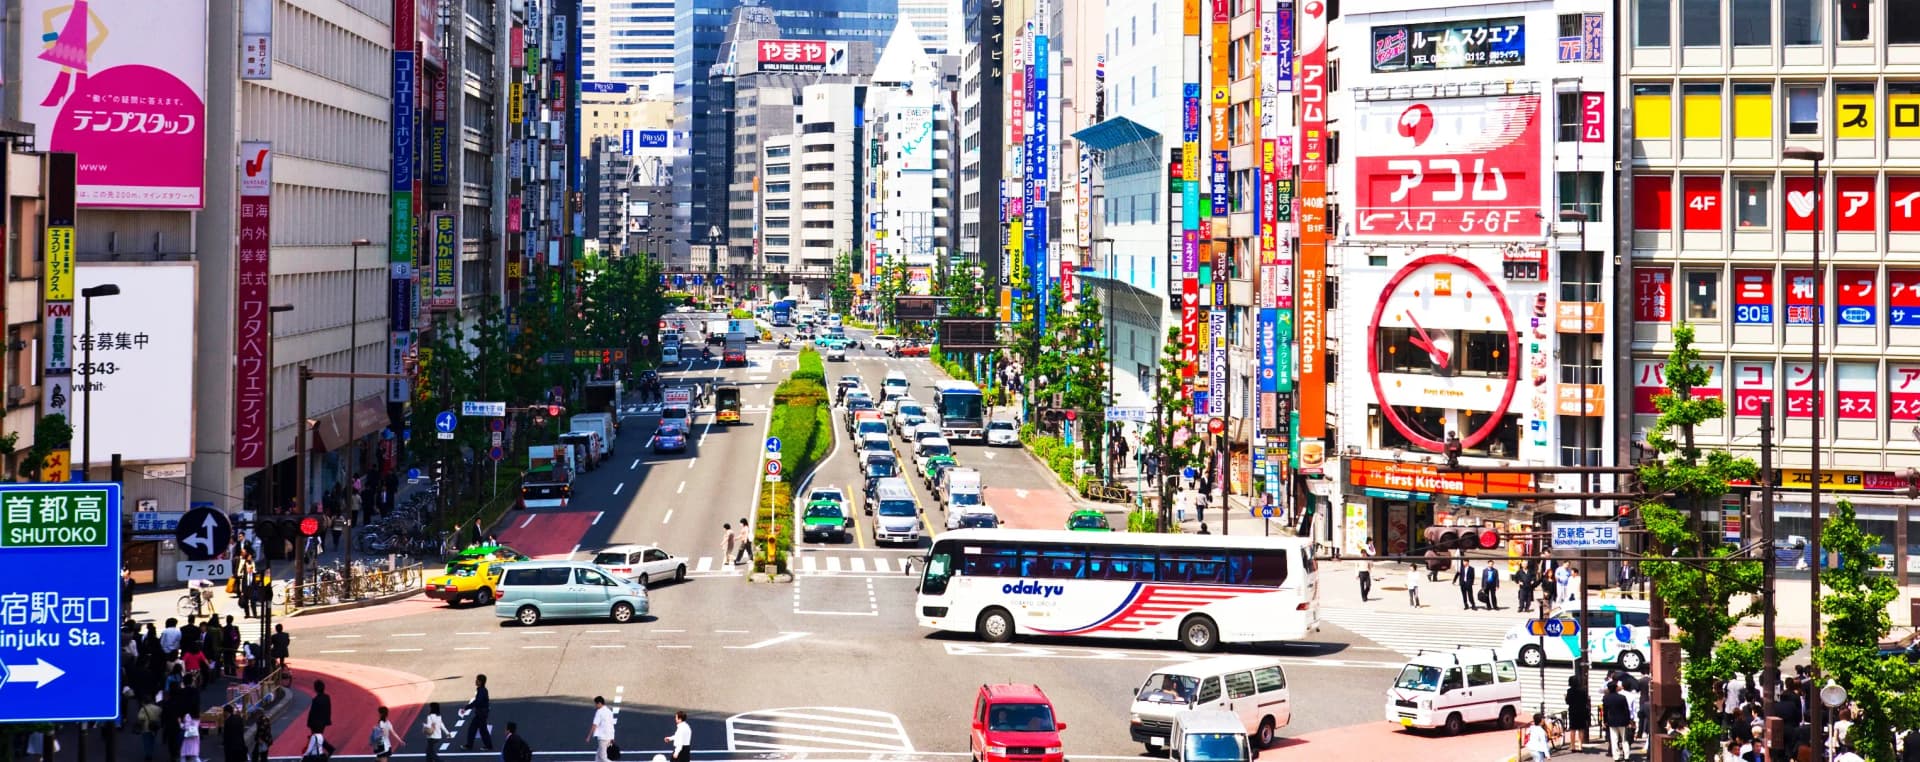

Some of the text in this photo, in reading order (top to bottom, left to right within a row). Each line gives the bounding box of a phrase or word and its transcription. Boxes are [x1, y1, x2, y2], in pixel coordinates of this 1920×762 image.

[762, 42, 822, 61] やまや
[1279, 40, 1291, 78] マイルド
[1560, 41, 1580, 59] 7F
[1303, 65, 1323, 122] アコム
[73, 110, 195, 134] テンプスタッフ
[1586, 96, 1601, 139] アコム
[1842, 104, 1920, 128] プロ
[642, 133, 664, 141] PRESSO
[80, 164, 107, 172] www
[1387, 158, 1507, 203] アコム
[1689, 196, 1716, 210] 4F
[1395, 211, 1436, 232] 入口
[241, 204, 253, 286] 国内挙式
[255, 204, 268, 286] 海外挙式
[438, 218, 453, 286] まんが喫茶
[50, 229, 60, 292] エスジーマックス
[1434, 279, 1450, 290] FK
[1639, 273, 1651, 318] コーナー
[1653, 272, 1665, 318] 無人契約
[47, 305, 71, 317] KM
[1303, 269, 1315, 374] First Kitchen
[1184, 307, 1197, 362] アイフル
[1215, 314, 1224, 335] Mac
[1215, 349, 1224, 363] PC
[1215, 365, 1224, 413] Collection
[1384, 474, 1464, 491] First Kitchen
[1846, 475, 1859, 484] 5F
[6, 496, 102, 524] 首都高
[11, 526, 97, 544] SHUTOKO
[1557, 527, 1613, 539] 西新宿一丁目
[185, 563, 225, 577] 7-20
[1002, 580, 1064, 597] odakyu
[0, 591, 110, 625] 宿駅西口
[0, 628, 105, 651] injuku Sta.
[1546, 623, 1561, 633] 414
